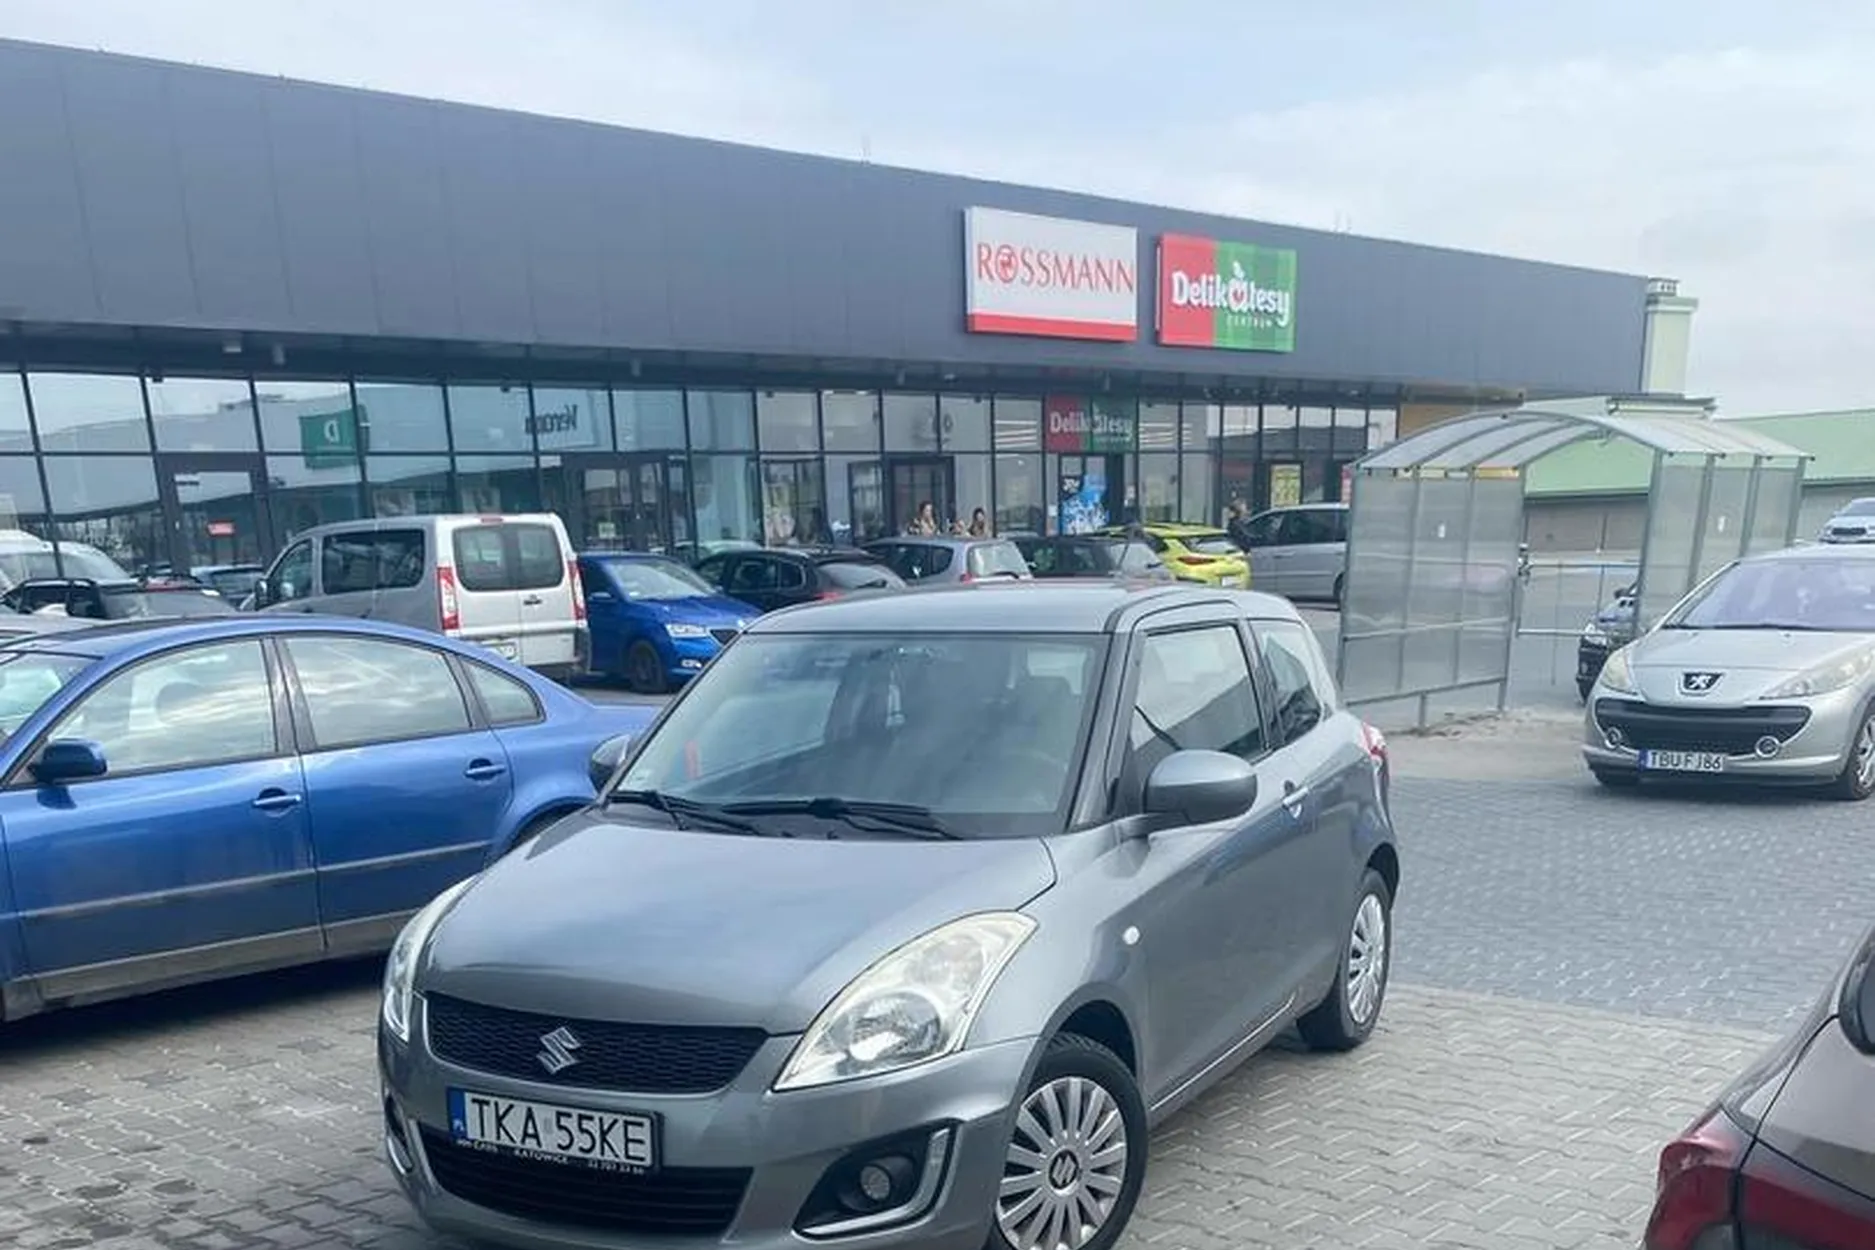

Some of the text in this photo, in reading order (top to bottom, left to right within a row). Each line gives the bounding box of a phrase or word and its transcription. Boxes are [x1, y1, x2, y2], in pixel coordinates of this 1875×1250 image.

[977, 243, 1134, 293] ROSSMANN
[1171, 267, 1290, 326] Delikatesy
[471, 1097, 646, 1162] TKA 55KE
